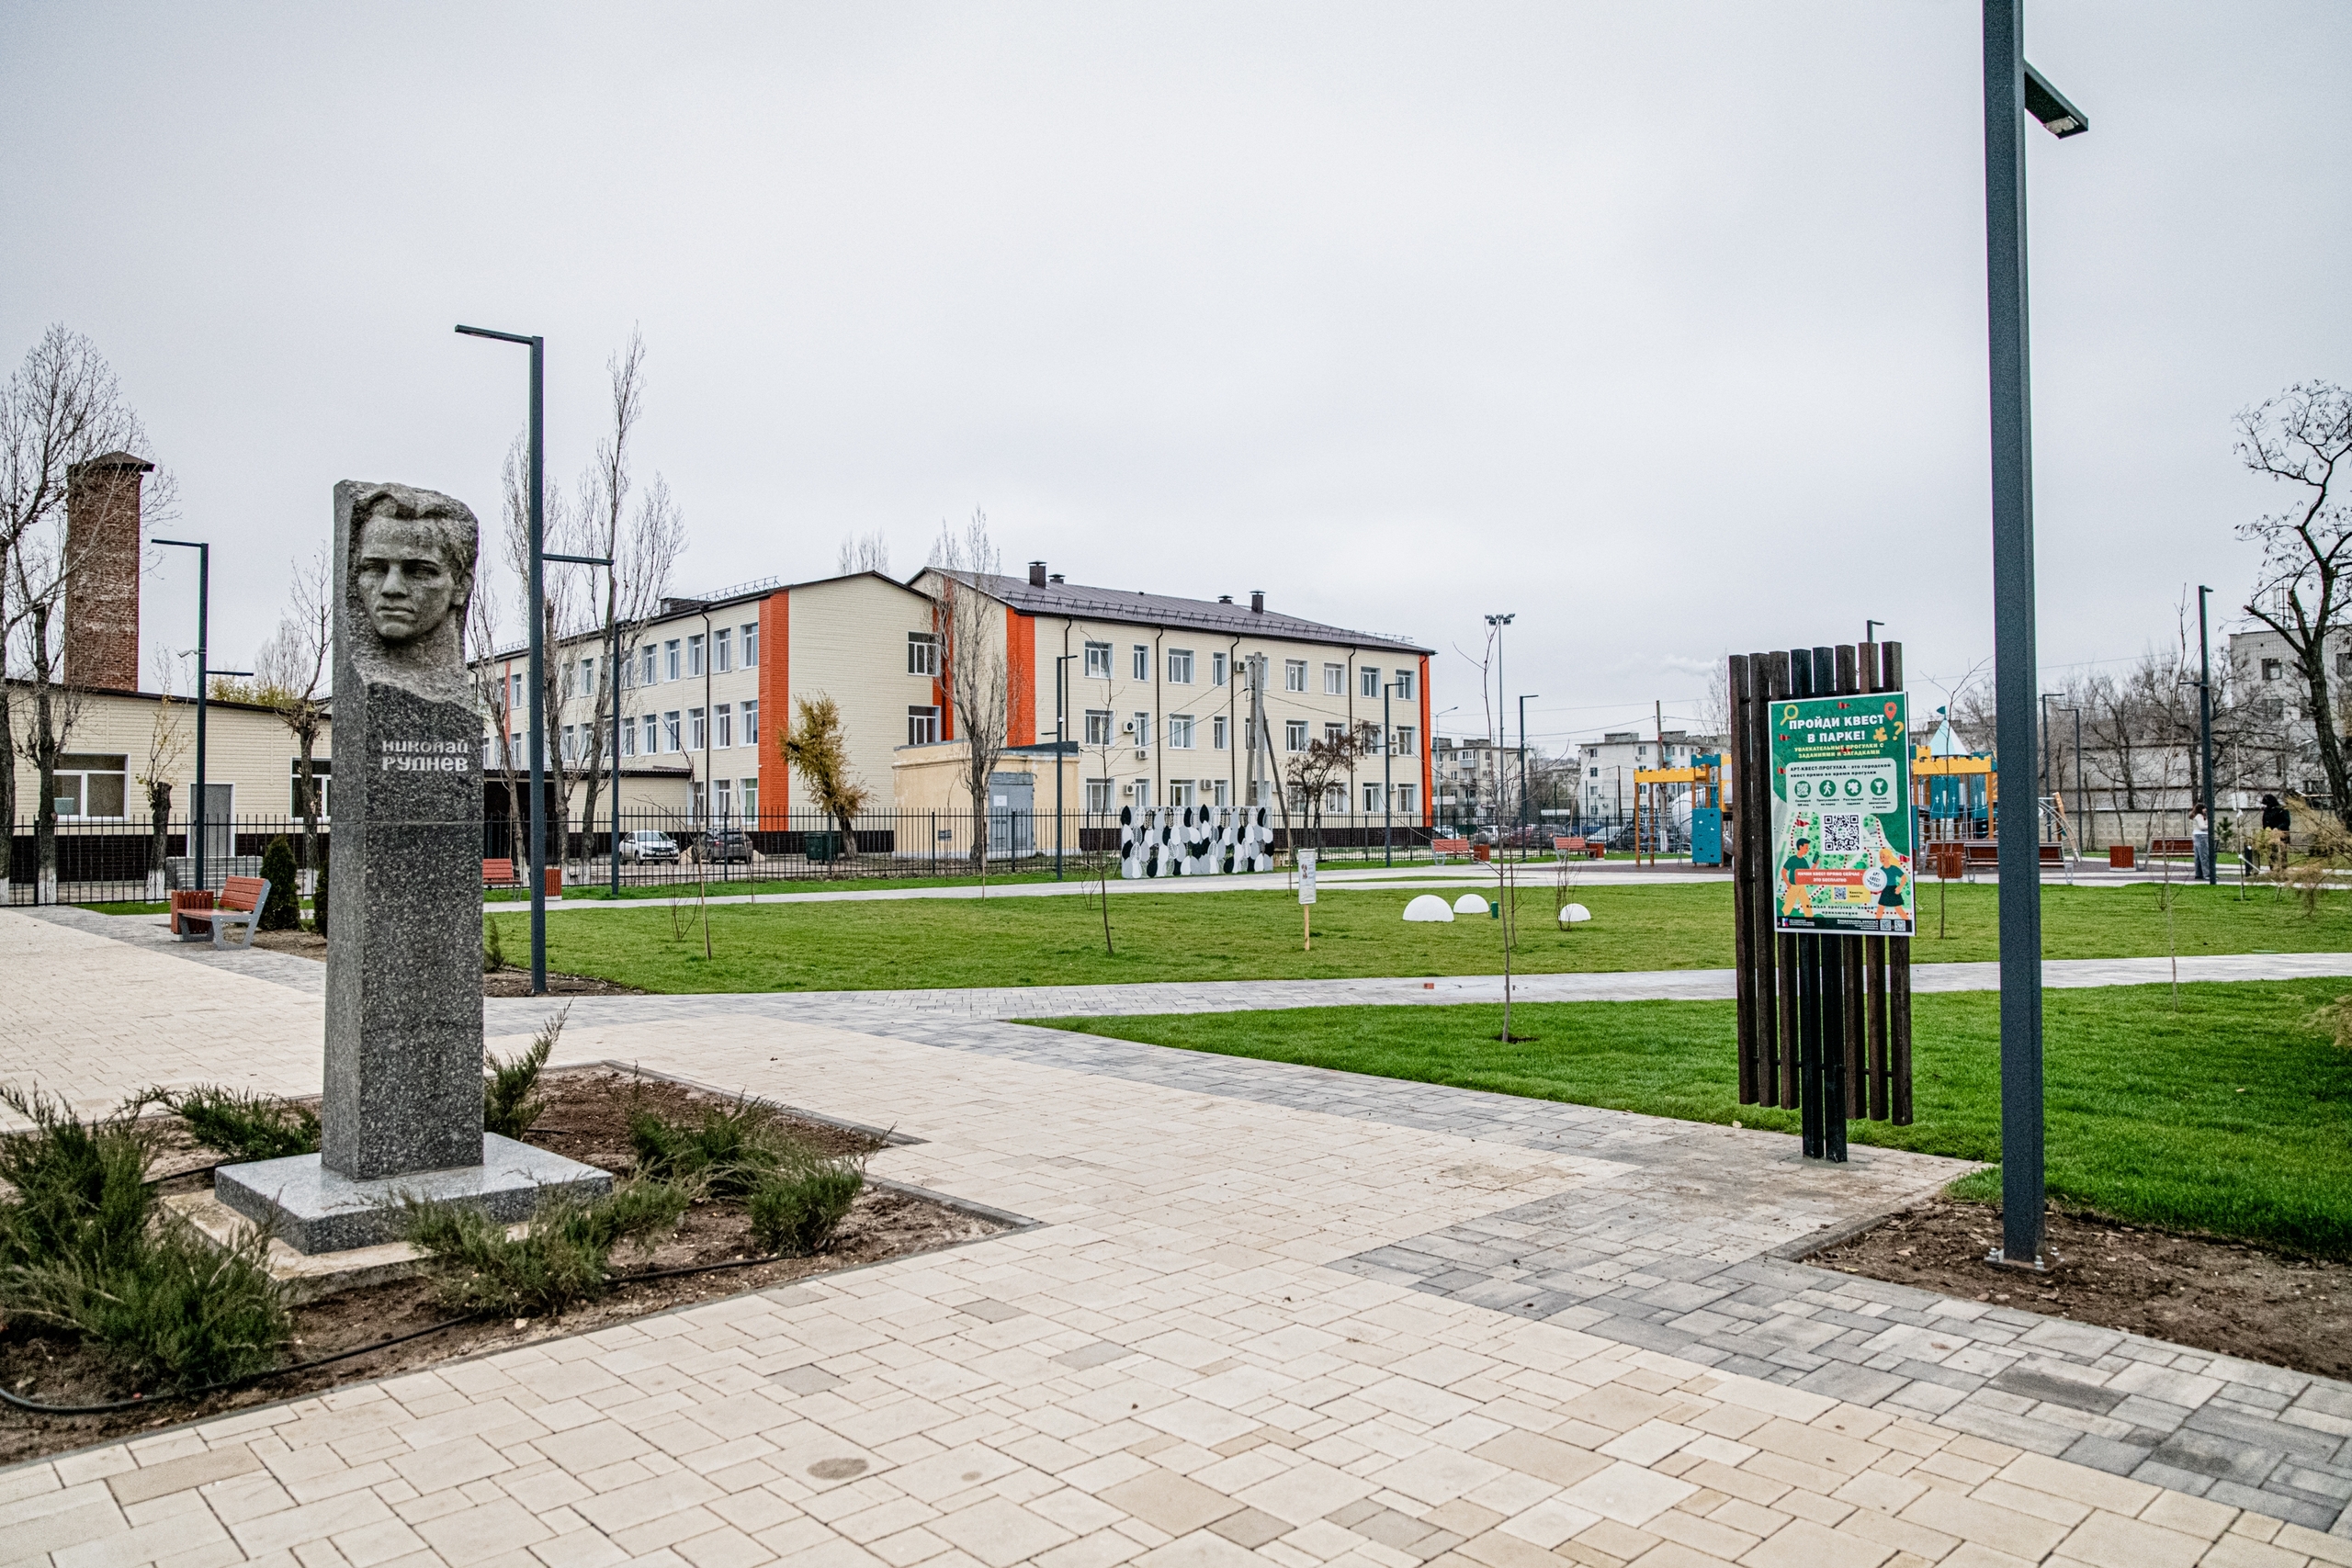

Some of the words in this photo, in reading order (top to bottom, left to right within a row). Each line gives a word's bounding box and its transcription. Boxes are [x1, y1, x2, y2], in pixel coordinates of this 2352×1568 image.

[1789, 716, 1840, 729] ПРОЙДИ
[1844, 715, 1884, 727] КВЕСТ
[1807, 734, 1815, 743] В
[1819, 730, 1866, 742] ПАРКЕ!
